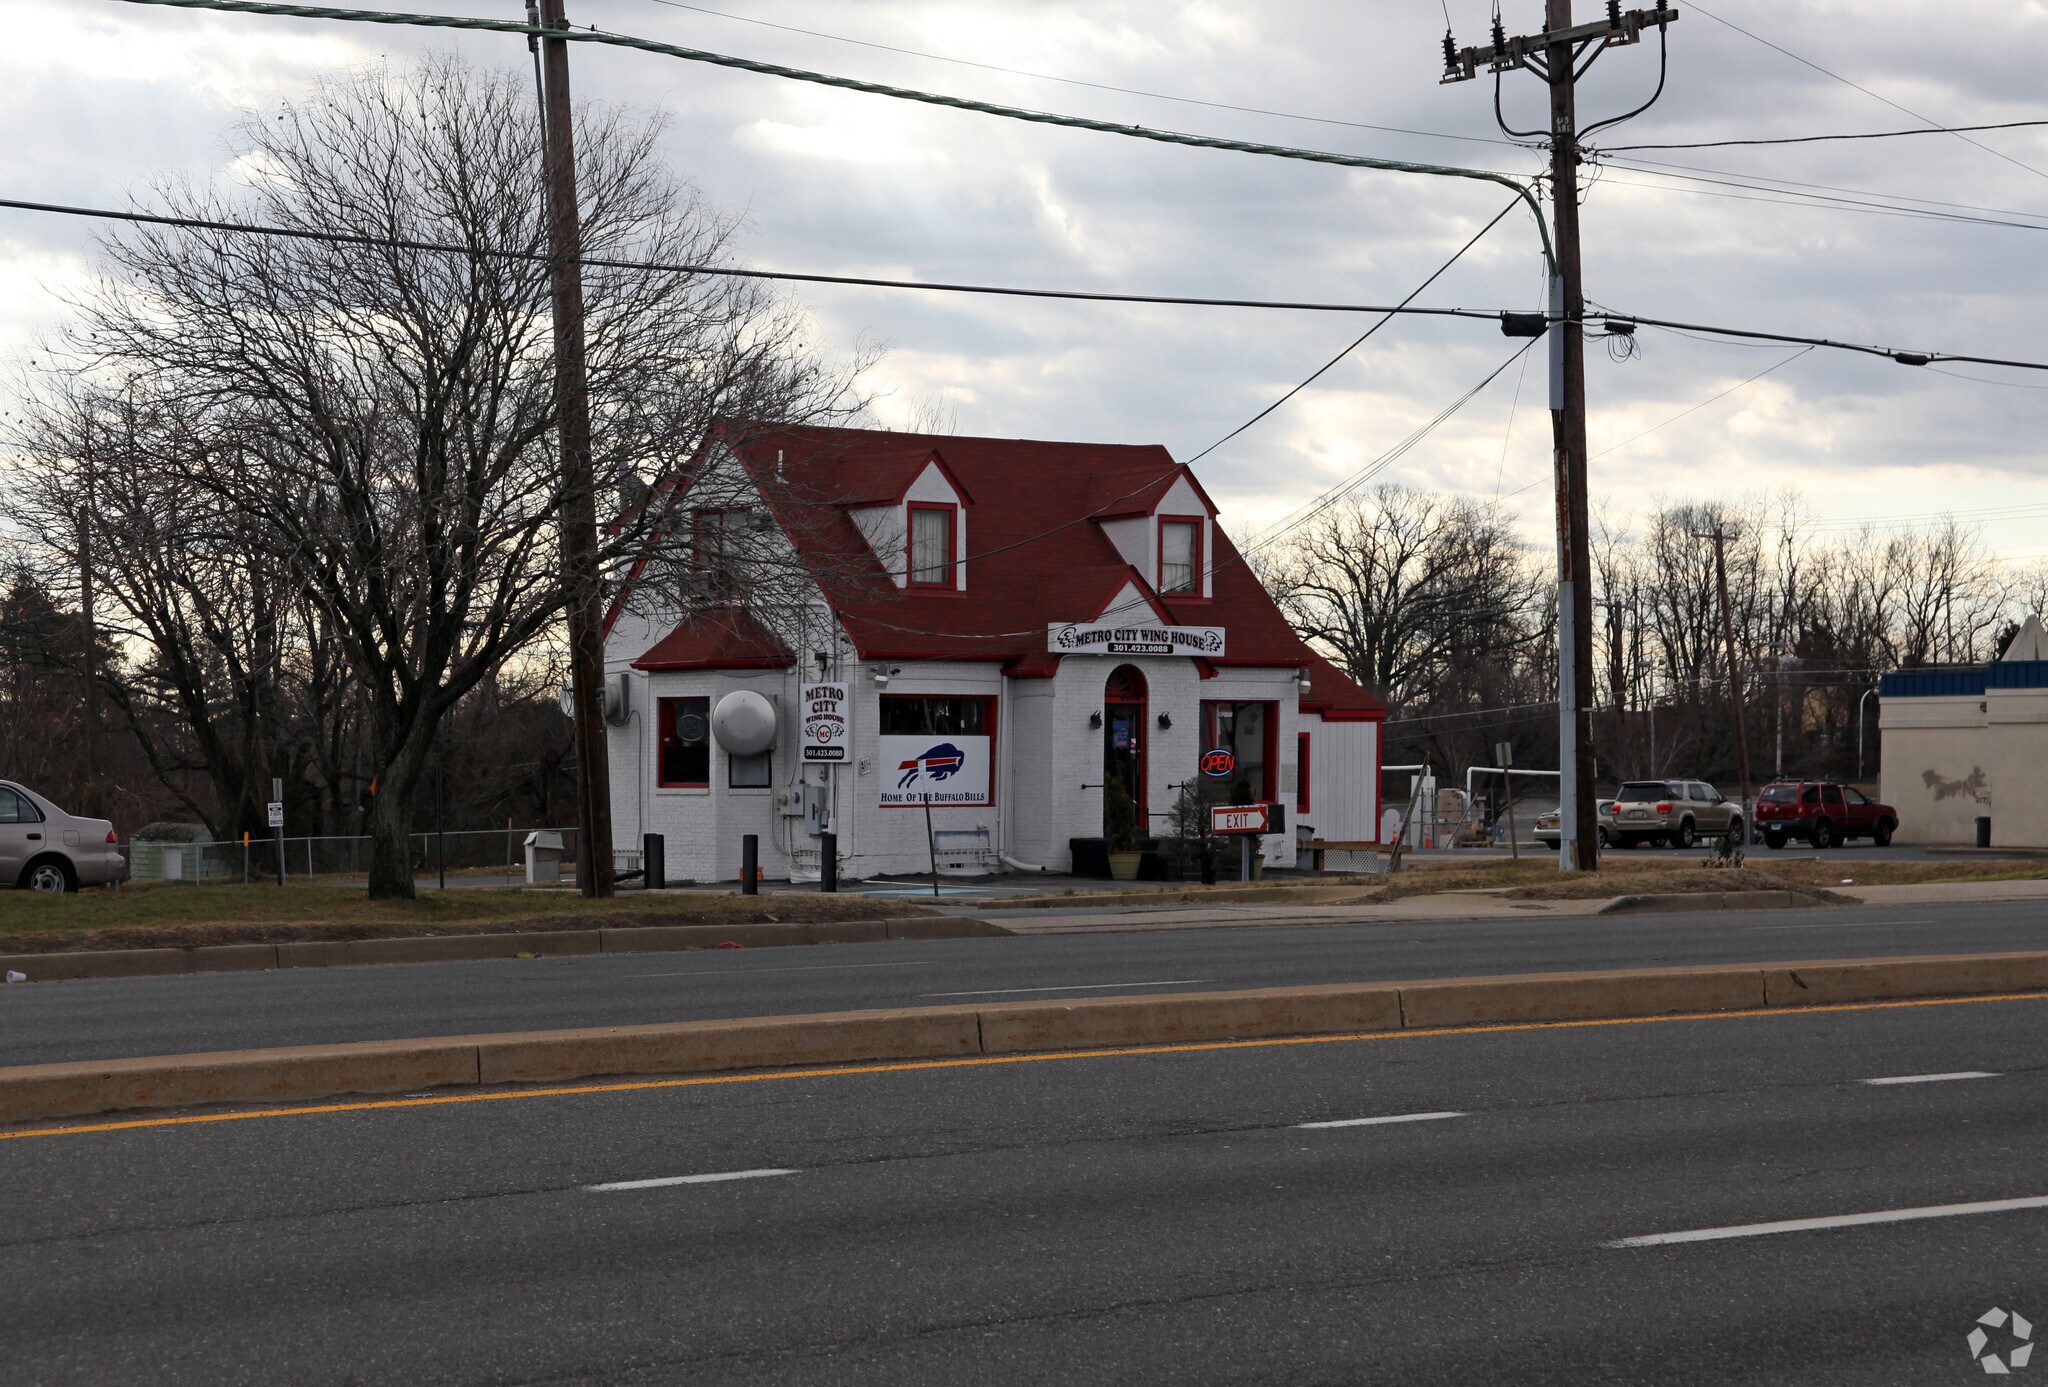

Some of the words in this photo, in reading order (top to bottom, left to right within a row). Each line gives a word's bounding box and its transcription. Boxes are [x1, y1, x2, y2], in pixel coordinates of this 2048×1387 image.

[1075, 630, 1112, 648] METRO
[1114, 629, 1139, 642] CITY
[1140, 629, 1169, 642] WING
[1171, 632, 1205, 650] HOUSE
[1113, 644, 1169, 653] 301.423.0088
[805, 686, 844, 702] METRO
[812, 700, 838, 713] CITY
[805, 714, 823, 723] WING
[823, 714, 845, 724] HOUSE
[805, 749, 843, 757] 301.423.0088
[1201, 754, 1235, 771] OPEN
[1226, 813, 1249, 828] EXIT
